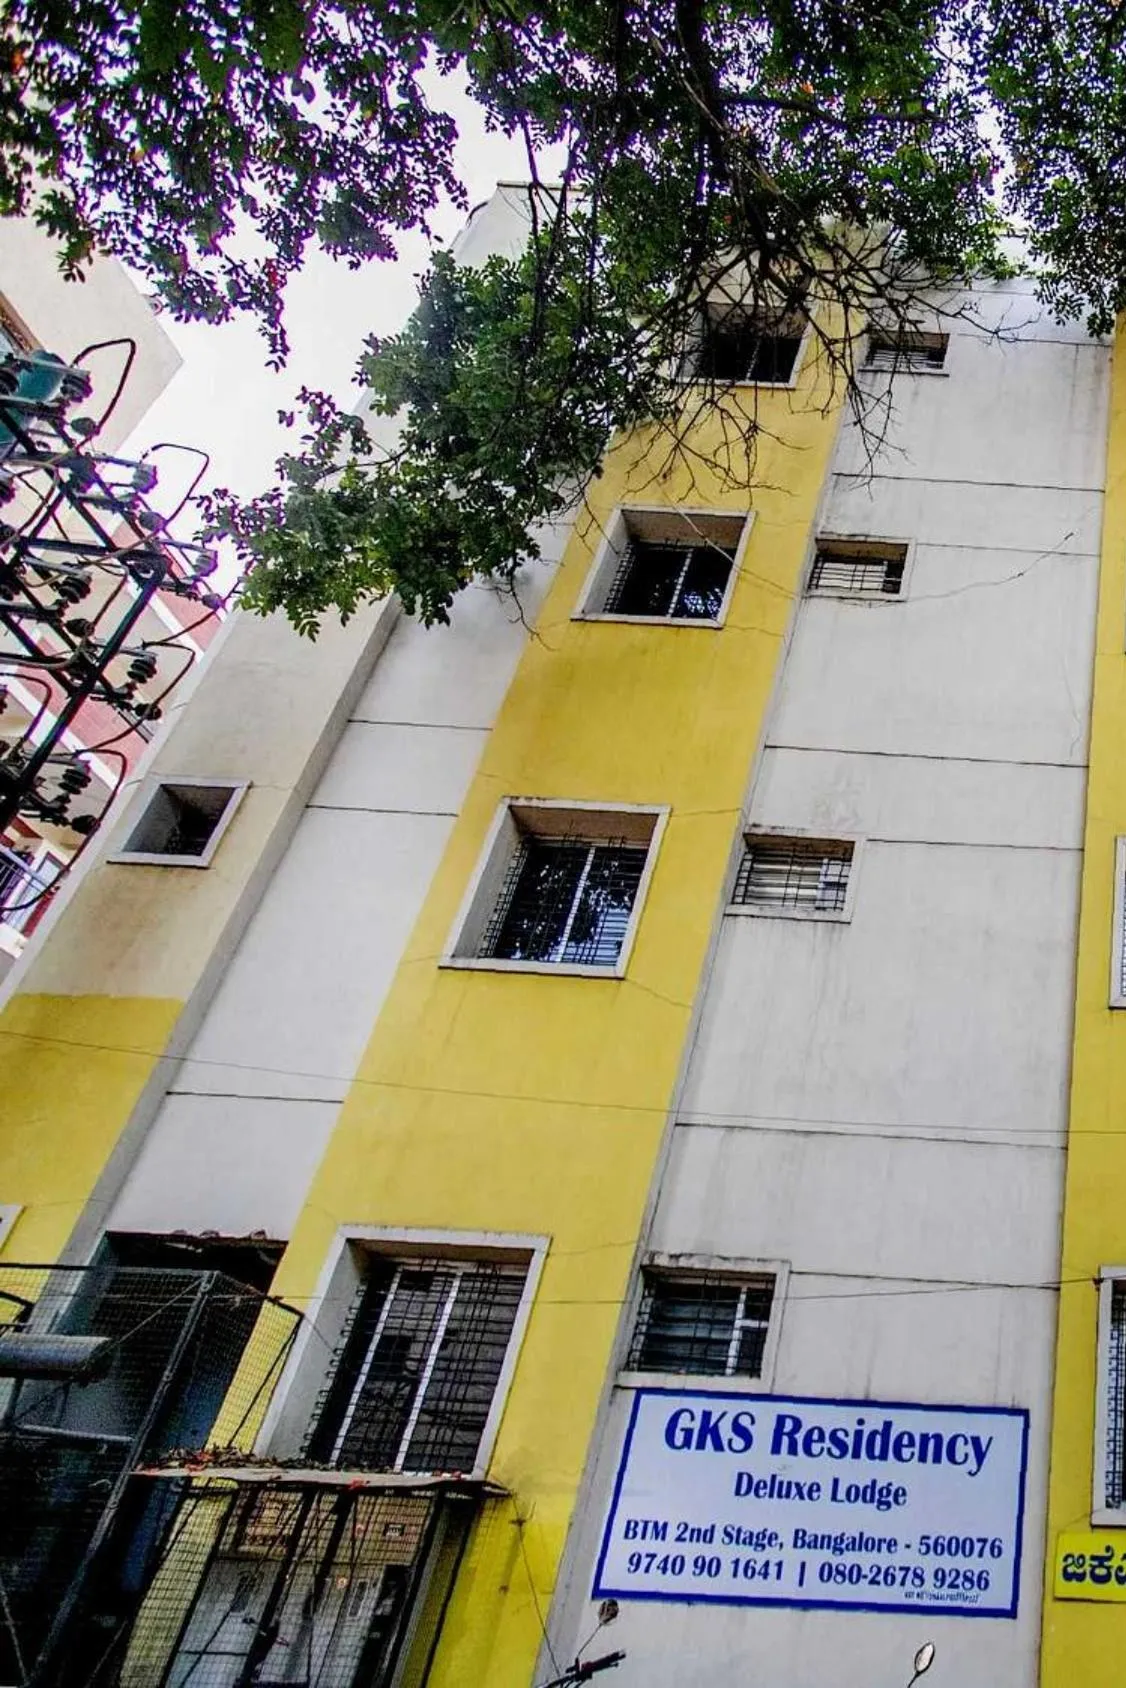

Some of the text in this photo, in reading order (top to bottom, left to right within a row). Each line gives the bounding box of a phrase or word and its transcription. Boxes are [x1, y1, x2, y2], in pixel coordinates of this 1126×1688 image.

[664, 1407, 994, 1476] GKS Residency
[733, 1471, 908, 1512] Deluxe Lodge
[623, 1519, 669, 1542] BTM
[674, 1521, 716, 1545] 2nd
[721, 1524, 785, 1553] Stage,
[792, 1527, 899, 1557] Bangalore
[917, 1534, 1004, 1560] 560076
[627, 1551, 686, 1577] 9740
[691, 1554, 722, 1578] 90
[730, 1557, 785, 1582] 1641
[818, 1561, 926, 1589] 080-2678
[932, 1566, 991, 1592] 9286
